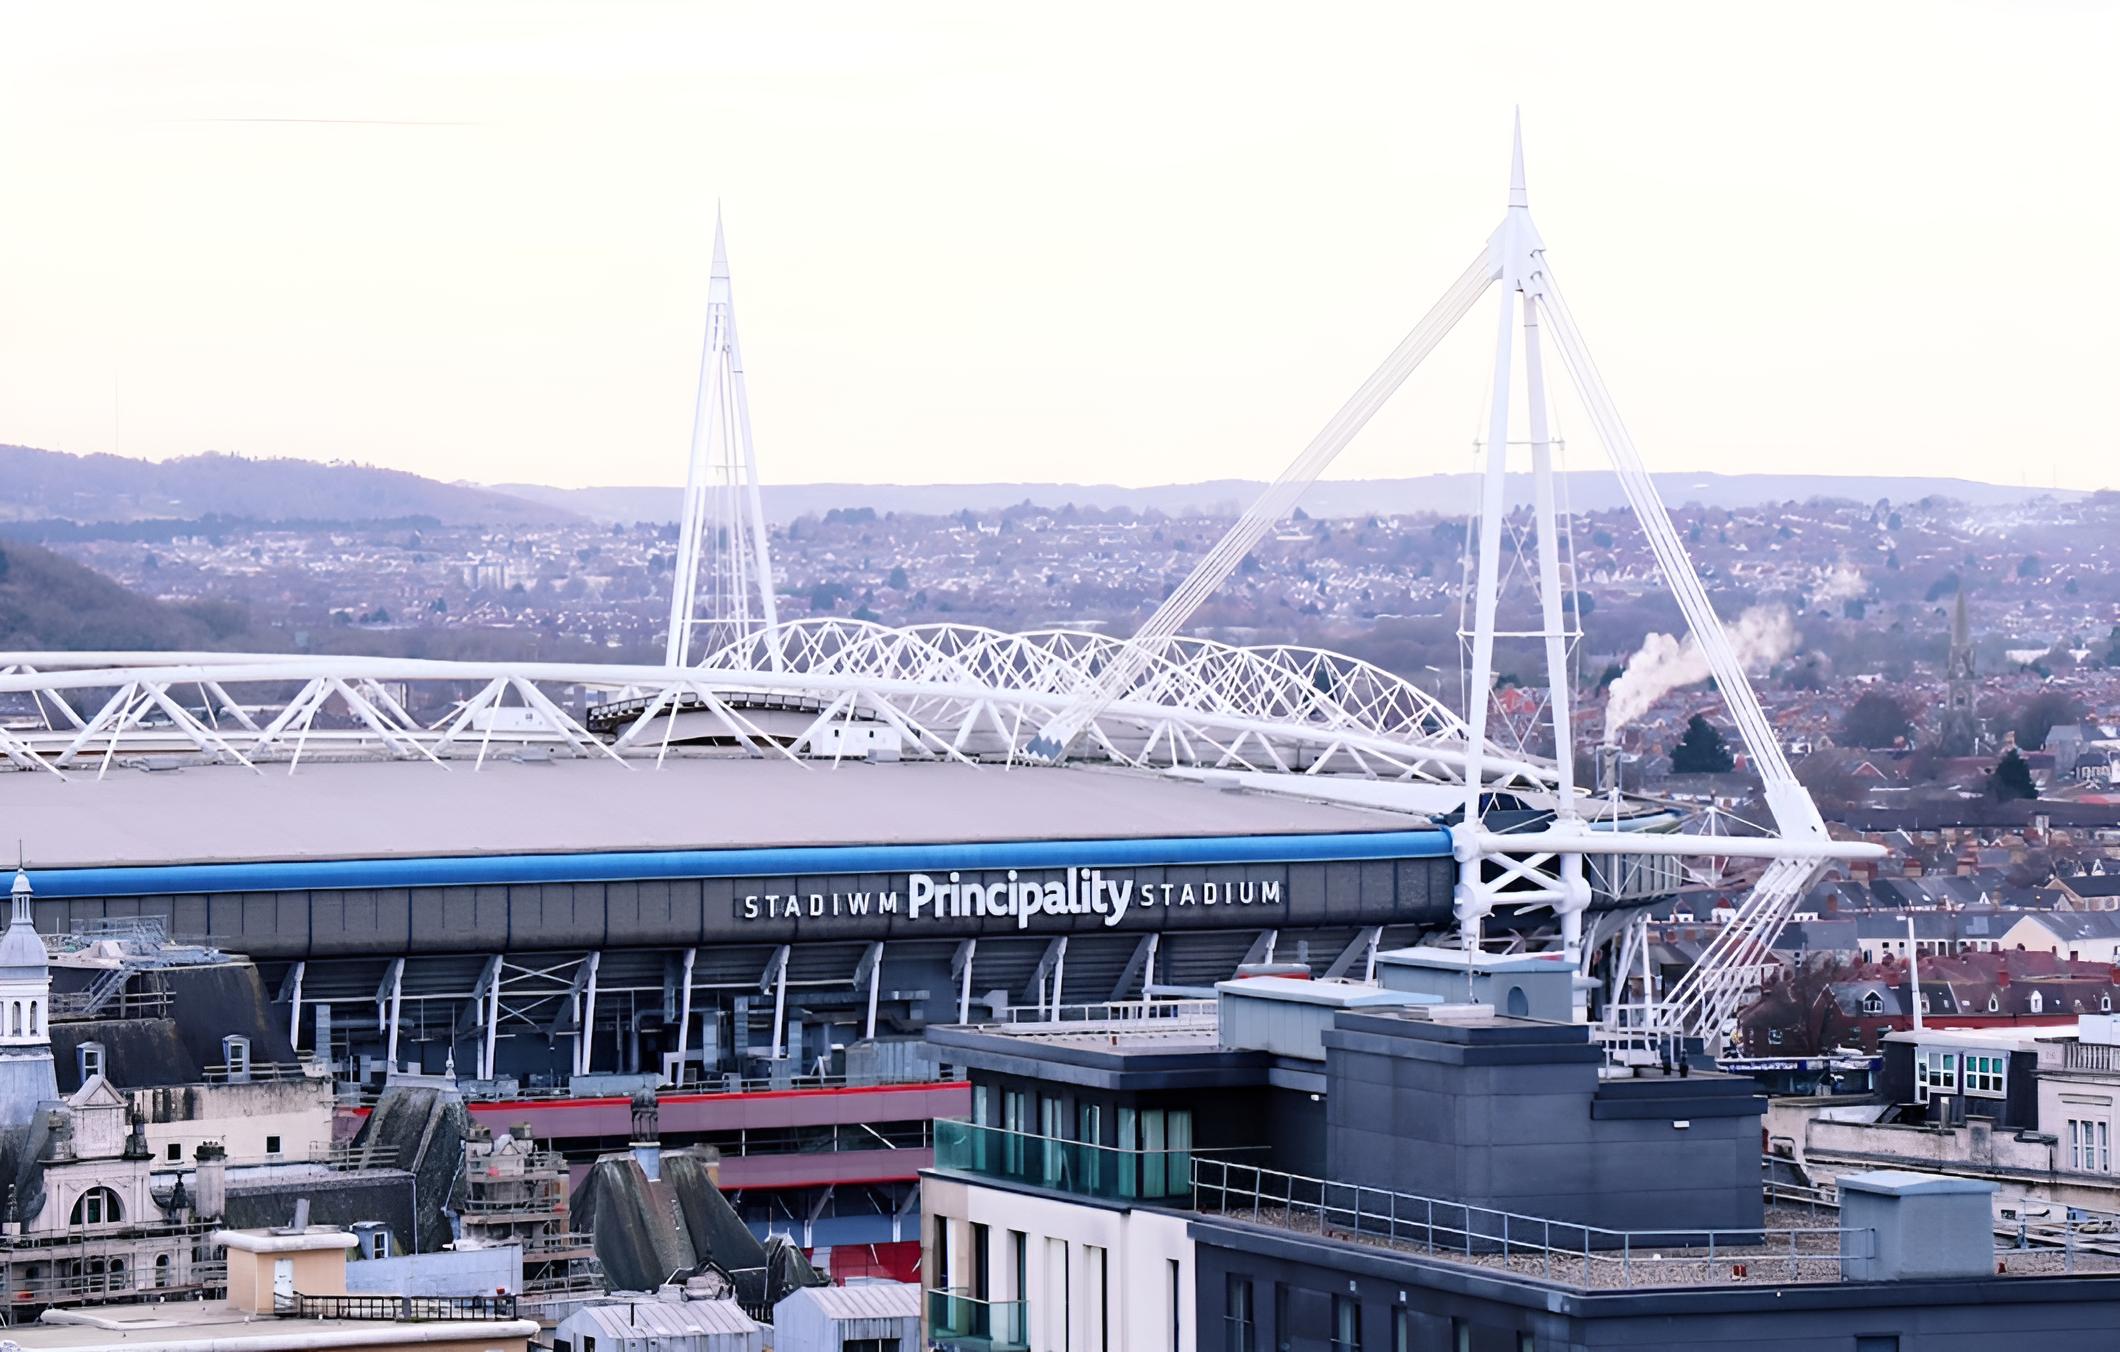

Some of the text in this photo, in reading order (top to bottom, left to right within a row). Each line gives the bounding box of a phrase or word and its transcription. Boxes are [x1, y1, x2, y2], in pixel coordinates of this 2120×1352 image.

[744, 867, 1281, 929] STADIWM Principality STADIUM
